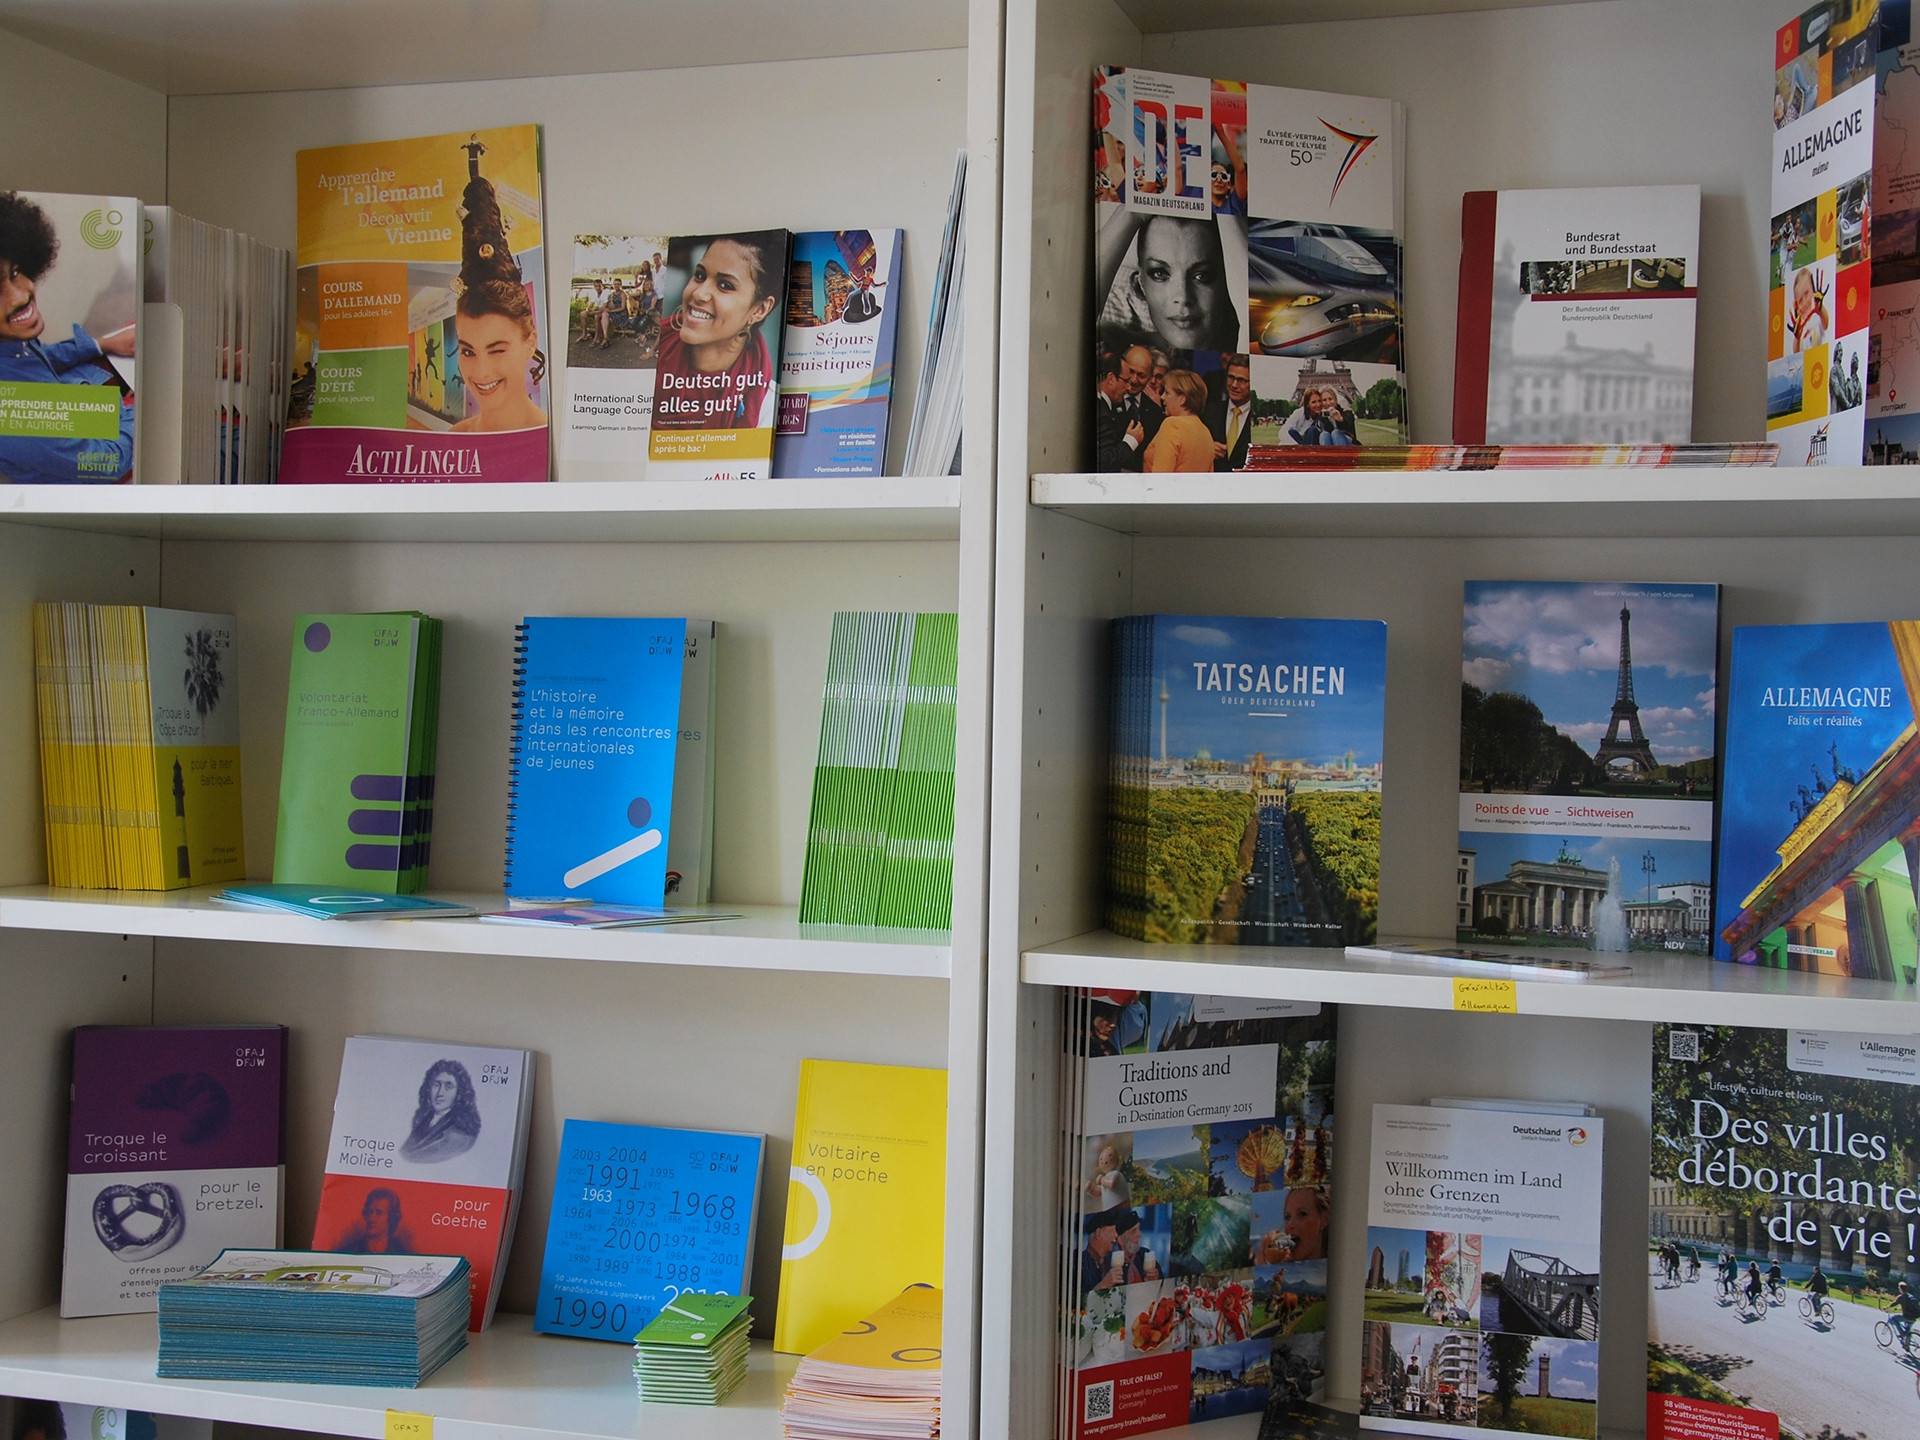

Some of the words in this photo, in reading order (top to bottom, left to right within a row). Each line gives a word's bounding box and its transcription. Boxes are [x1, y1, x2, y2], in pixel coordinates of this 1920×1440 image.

[1259, 137, 1284, 146] TRAITÉ
[1296, 141, 1327, 150] L'ÉLYSÉE
[1266, 129, 1327, 142] ÉLYSÉE-VERTRAG
[1782, 109, 1863, 173] ALLEMAGNE
[1290, 149, 1313, 167] 50
[317, 167, 396, 191] Apprendre
[343, 178, 445, 206] l'allemand
[1133, 195, 1160, 207] MAGAZIN
[1161, 198, 1205, 212] DEUTSCHLAND
[358, 208, 432, 228] Découvrir
[384, 227, 452, 245] Vienne
[1565, 231, 1621, 243] Bundesrat
[1565, 245, 1586, 255] und
[1590, 243, 1657, 255] Bundesstaat
[322, 281, 364, 294] COURS
[323, 293, 402, 310] D'ALLEMAND
[1562, 305, 1573, 313] Der
[1575, 305, 1608, 313] Bundesrat
[1609, 304, 1620, 312] der
[323, 311, 341, 322] pour
[341, 310, 352, 319] les
[353, 308, 380, 319] adultes
[380, 308, 393, 317] 16+
[1561, 313, 1611, 323] Bundesrepublik
[1612, 312, 1654, 321] Deutschland
[815, 331, 874, 350] Séjours
[320, 366, 363, 379] COURS
[782, 357, 872, 376] nguistiques
[320, 379, 356, 393] D'ÉTÉ
[661, 371, 732, 390] Deutsch
[736, 370, 769, 392] gut,
[318, 395, 338, 404] pour
[338, 394, 349, 403] les
[349, 394, 376, 404] jeunes
[573, 392, 635, 404] International
[658, 396, 700, 414] alles
[56, 401, 116, 413] L'ALLEMAND
[573, 404, 622, 415] Language
[624, 405, 652, 415] Cours
[9, 410, 70, 421] ALLEMAGNE
[9, 420, 23, 430] EN
[26, 421, 75, 432] AUTRICHE
[571, 424, 597, 432] Learning
[655, 433, 695, 443] Continuez
[695, 433, 737, 442] l'allemand
[76, 451, 119, 463] GOETHE
[654, 444, 677, 454] après
[677, 444, 686, 453] le
[686, 444, 701, 453] bac
[76, 462, 119, 473] INSTITUT
[374, 629, 399, 638] OFAJ
[1193, 661, 1346, 696] TATSACHEN
[299, 691, 369, 704] Volontariat
[531, 688, 597, 703] L'histoire
[1221, 695, 1245, 706] ÜBER
[1250, 697, 1317, 708] DEUTSCHLAND
[1760, 686, 1892, 709] ALLEMAGNE
[529, 706, 546, 719] et
[552, 706, 564, 719] la
[569, 705, 625, 721] mémoire
[1787, 715, 1811, 726] Faits
[1813, 716, 1823, 726] et
[1826, 715, 1863, 727] réalités
[528, 721, 562, 736] dans
[567, 723, 587, 737] les
[592, 725, 672, 740] rencontres
[527, 737, 635, 755] internationales
[526, 755, 544, 768] de
[547, 754, 595, 772] jeunes
[1475, 802, 1510, 815] Points
[1511, 804, 1527, 816] de
[1528, 806, 1550, 816] vue
[1566, 805, 1635, 819] Sichtweisen
[1254, 920, 1290, 928] Wissenschaft
[1293, 921, 1321, 929] Wirtschaft
[1663, 940, 1686, 950] NDV
[1460, 999, 1511, 1013] Allemagne
[235, 1047, 265, 1058] OFAJ
[1859, 1040, 1917, 1057] L'Allemagne
[235, 1057, 266, 1068] DFJW
[481, 1064, 509, 1075] OFAJ
[1119, 1060, 1198, 1084] Traditions
[1202, 1054, 1231, 1077] and
[481, 1074, 509, 1085] DFJW
[1118, 1086, 1188, 1108] Customs
[1708, 1080, 1750, 1096] Lifestyle,
[1750, 1085, 1784, 1098] culture
[1785, 1090, 1796, 1099] et
[1796, 1089, 1824, 1104] loisirs
[1117, 1112, 1127, 1125] in
[1130, 1107, 1185, 1123] Destination
[1187, 1103, 1232, 1118] Germany
[1232, 1102, 1253, 1115] 2015
[1512, 1125, 1562, 1137] Deutschland
[1690, 1099, 1769, 1146] Des
[1782, 1111, 1887, 1162] villes
[84, 1132, 145, 1149] Troque
[152, 1131, 168, 1145] le
[342, 1134, 396, 1153] Troque
[83, 1148, 168, 1165] croissant
[338, 1151, 394, 1169] Molière
[607, 1146, 647, 1164] 2004
[808, 1142, 881, 1163] Voltaire
[583, 1163, 641, 1191] 1991
[805, 1163, 826, 1177] en
[832, 1167, 888, 1184] poche
[1384, 1160, 1489, 1184] Willkommen
[1494, 1168, 1515, 1185] im
[1520, 1170, 1563, 1190] Land
[1678, 1144, 1920, 1215] débordante
[200, 1181, 240, 1199] pour
[247, 1179, 261, 1194] le
[1383, 1182, 1425, 1199] ohne
[1429, 1183, 1501, 1204] Grenzen
[195, 1196, 264, 1212] bretzel.
[453, 1198, 492, 1214] pour
[581, 1187, 613, 1203] 1963
[668, 1190, 736, 1221] 1968
[430, 1211, 489, 1231] Goethe
[1767, 1201, 1817, 1247] de
[1829, 1216, 1892, 1259] vie
[603, 1227, 661, 1254] 2000
[128, 1266, 161, 1276] Offres
[163, 1265, 186, 1275] pour
[566, 1275, 588, 1284] Jahre
[589, 1278, 627, 1288] Deutsch-
[119, 1291, 131, 1300] et
[553, 1283, 609, 1297] Französisches
[610, 1291, 656, 1302] Jugendwerk
[549, 1296, 628, 1334] 1990
[1119, 1377, 1135, 1387] TRUE
[1134, 1375, 1144, 1384] OR
[1143, 1371, 1163, 1383] FALSE?
[1118, 1391, 1132, 1401] How
[1132, 1389, 1144, 1398] well
[1144, 1387, 1152, 1396] do
[1152, 1387, 1163, 1397] you
[1163, 1383, 1180, 1392] know
[1118, 1398, 1148, 1411] Germany?
[1663, 1399, 1674, 1408] 88
[1674, 1401, 1692, 1412] villes
[1664, 1409, 1678, 1417] 200
[1678, 1411, 1717, 1424] attractions
[1717, 1417, 1760, 1432] touristiques
[1694, 1421, 1737, 1436] événements
